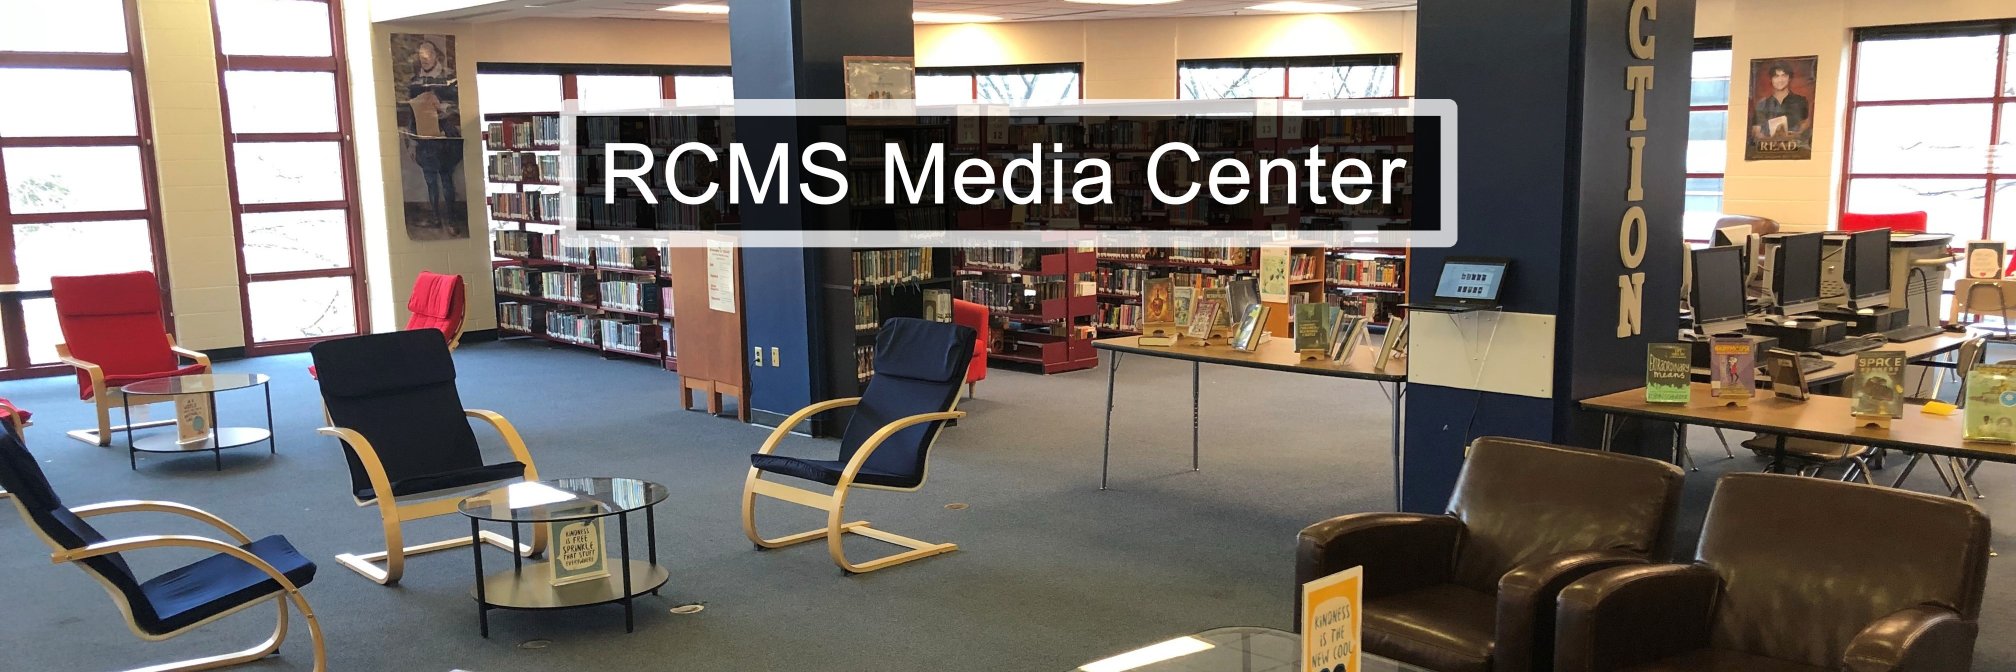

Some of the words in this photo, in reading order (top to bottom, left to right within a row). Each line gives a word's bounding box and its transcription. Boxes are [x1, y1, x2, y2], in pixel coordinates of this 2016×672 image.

[1759, 141, 1798, 151] READ
[1858, 357, 1901, 367] SPACE
[1653, 371, 1685, 379] means
[565, 528, 590, 537] KINDNESS
[572, 535, 588, 544] FREE
[562, 541, 594, 554] SPRINKLE
[563, 552, 577, 560] THAT
[1331, 625, 1345, 643] THE
[1311, 649, 1330, 668] NEW
[1333, 640, 1353, 660] COOL
